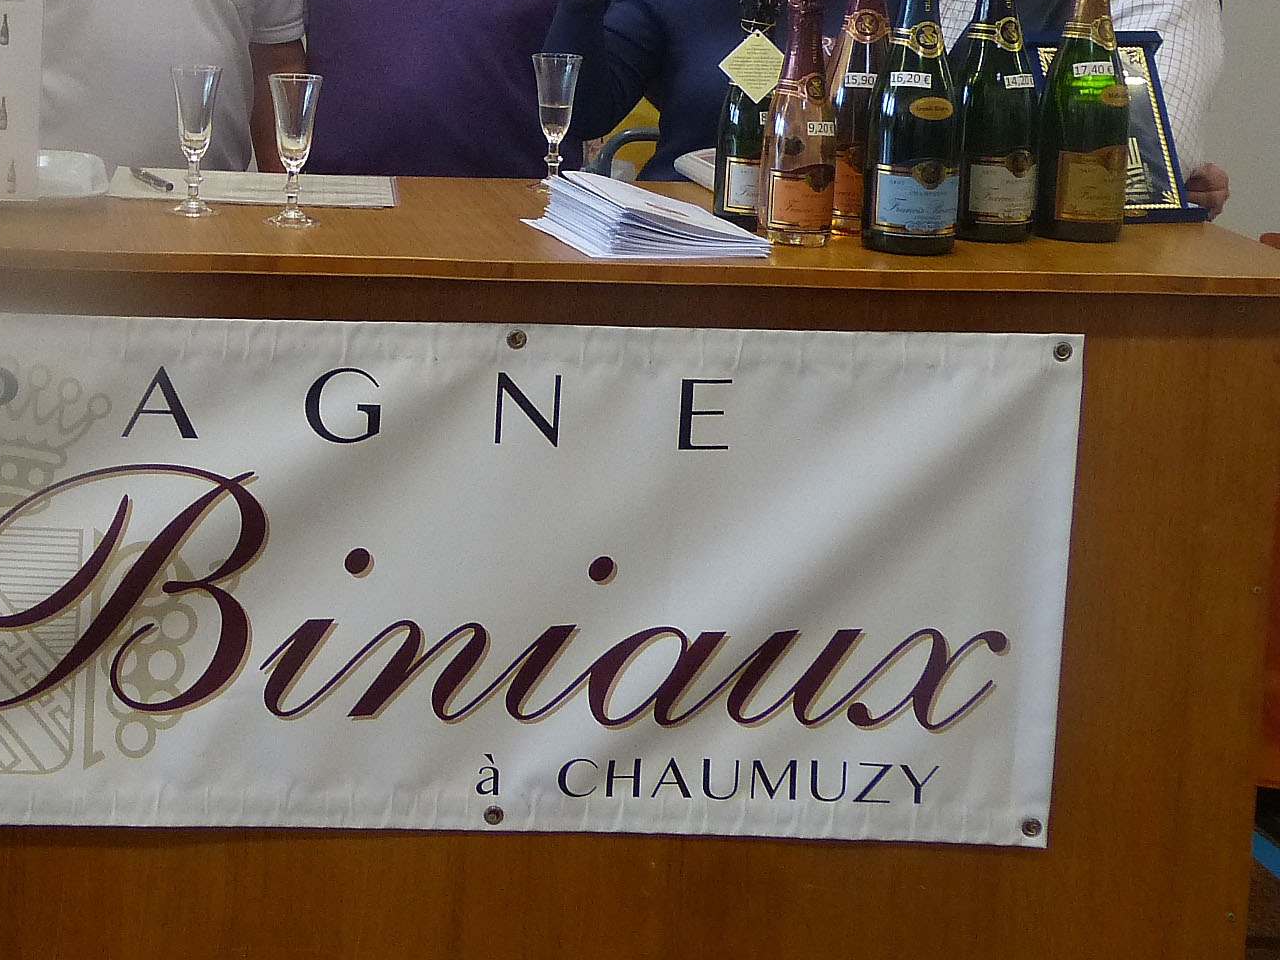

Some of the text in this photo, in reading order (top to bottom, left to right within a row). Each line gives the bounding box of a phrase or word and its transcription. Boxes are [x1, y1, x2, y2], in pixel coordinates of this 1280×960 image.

[1075, 64, 1105, 76] 17,40
[846, 74, 874, 88] 15,90
[892, 73, 931, 84] 16,20 €
[808, 123, 829, 134] 9,20
[475, 753, 502, 797] à
[557, 758, 940, 805] CHAUMUZY
